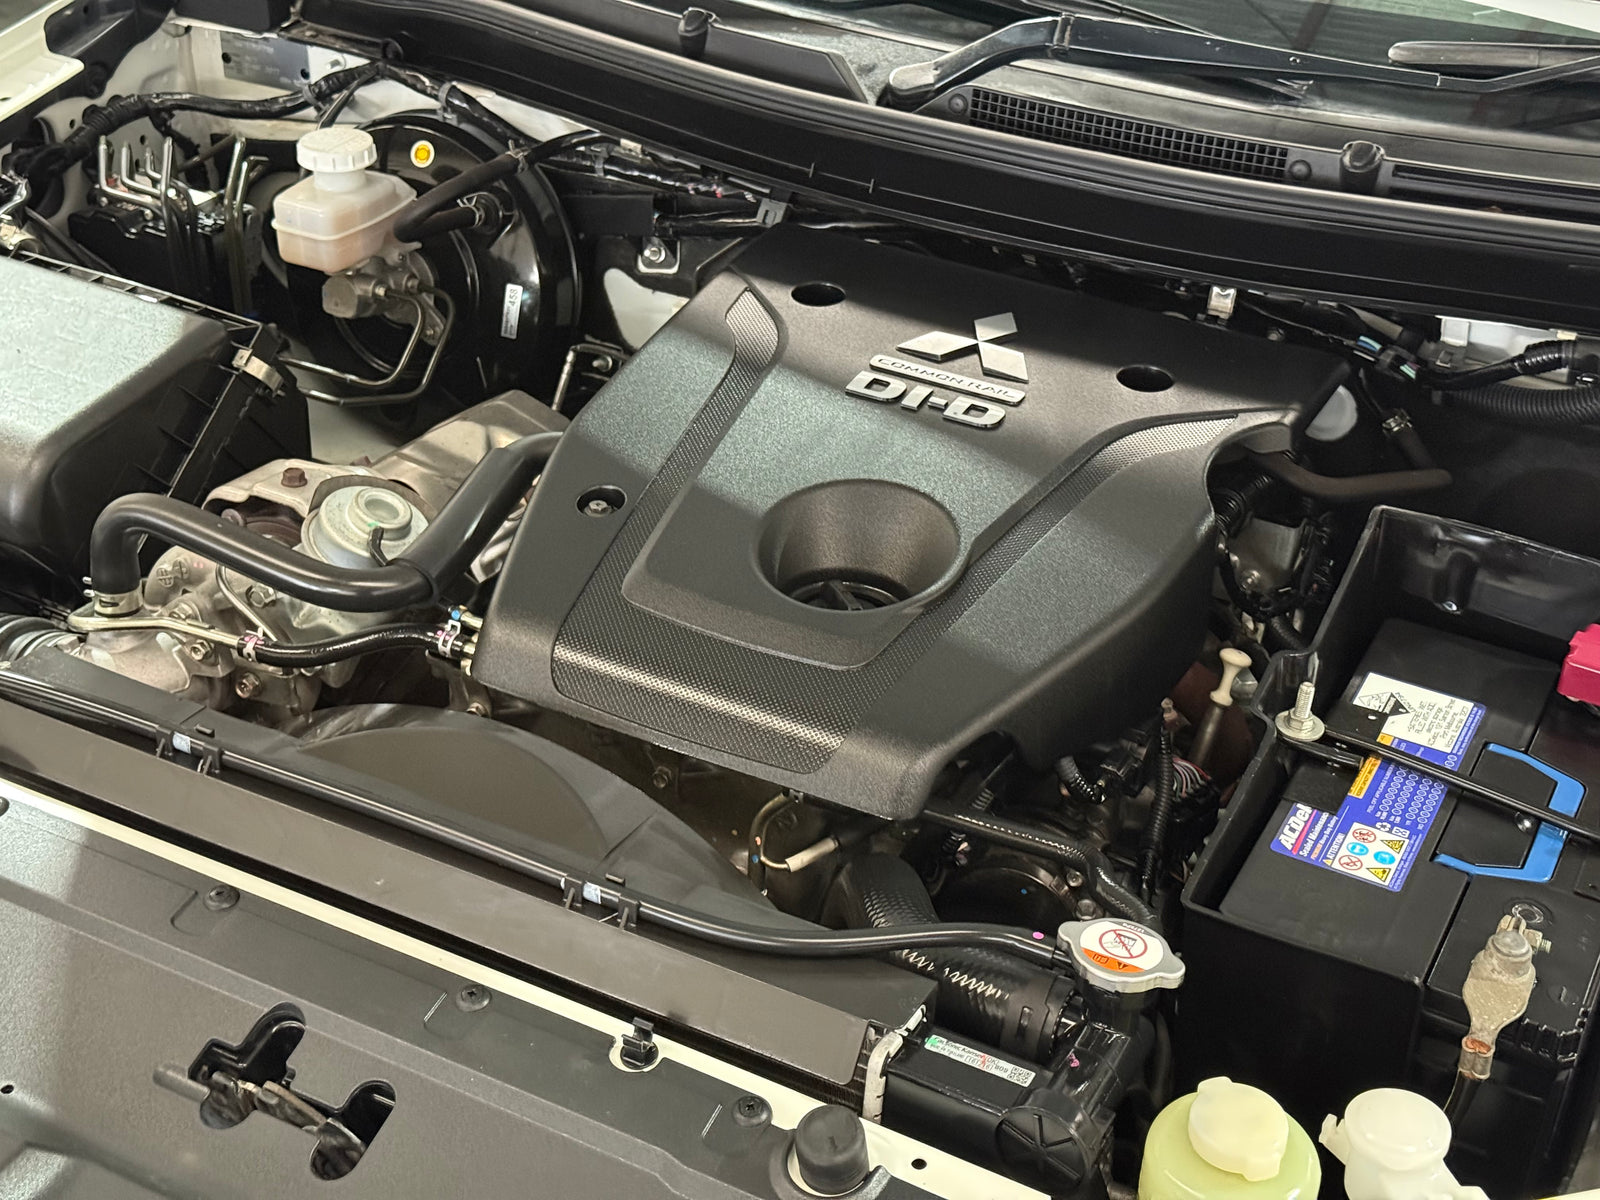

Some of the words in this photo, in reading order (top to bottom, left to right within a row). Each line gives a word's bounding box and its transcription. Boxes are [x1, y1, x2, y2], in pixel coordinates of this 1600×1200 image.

[845, 371, 1006, 429] DI-D
[878, 358, 963, 385] COMMON
[967, 382, 1016, 399] RAIL
[1279, 803, 1313, 851] ACDel
[1299, 838, 1315, 857] Sealed
